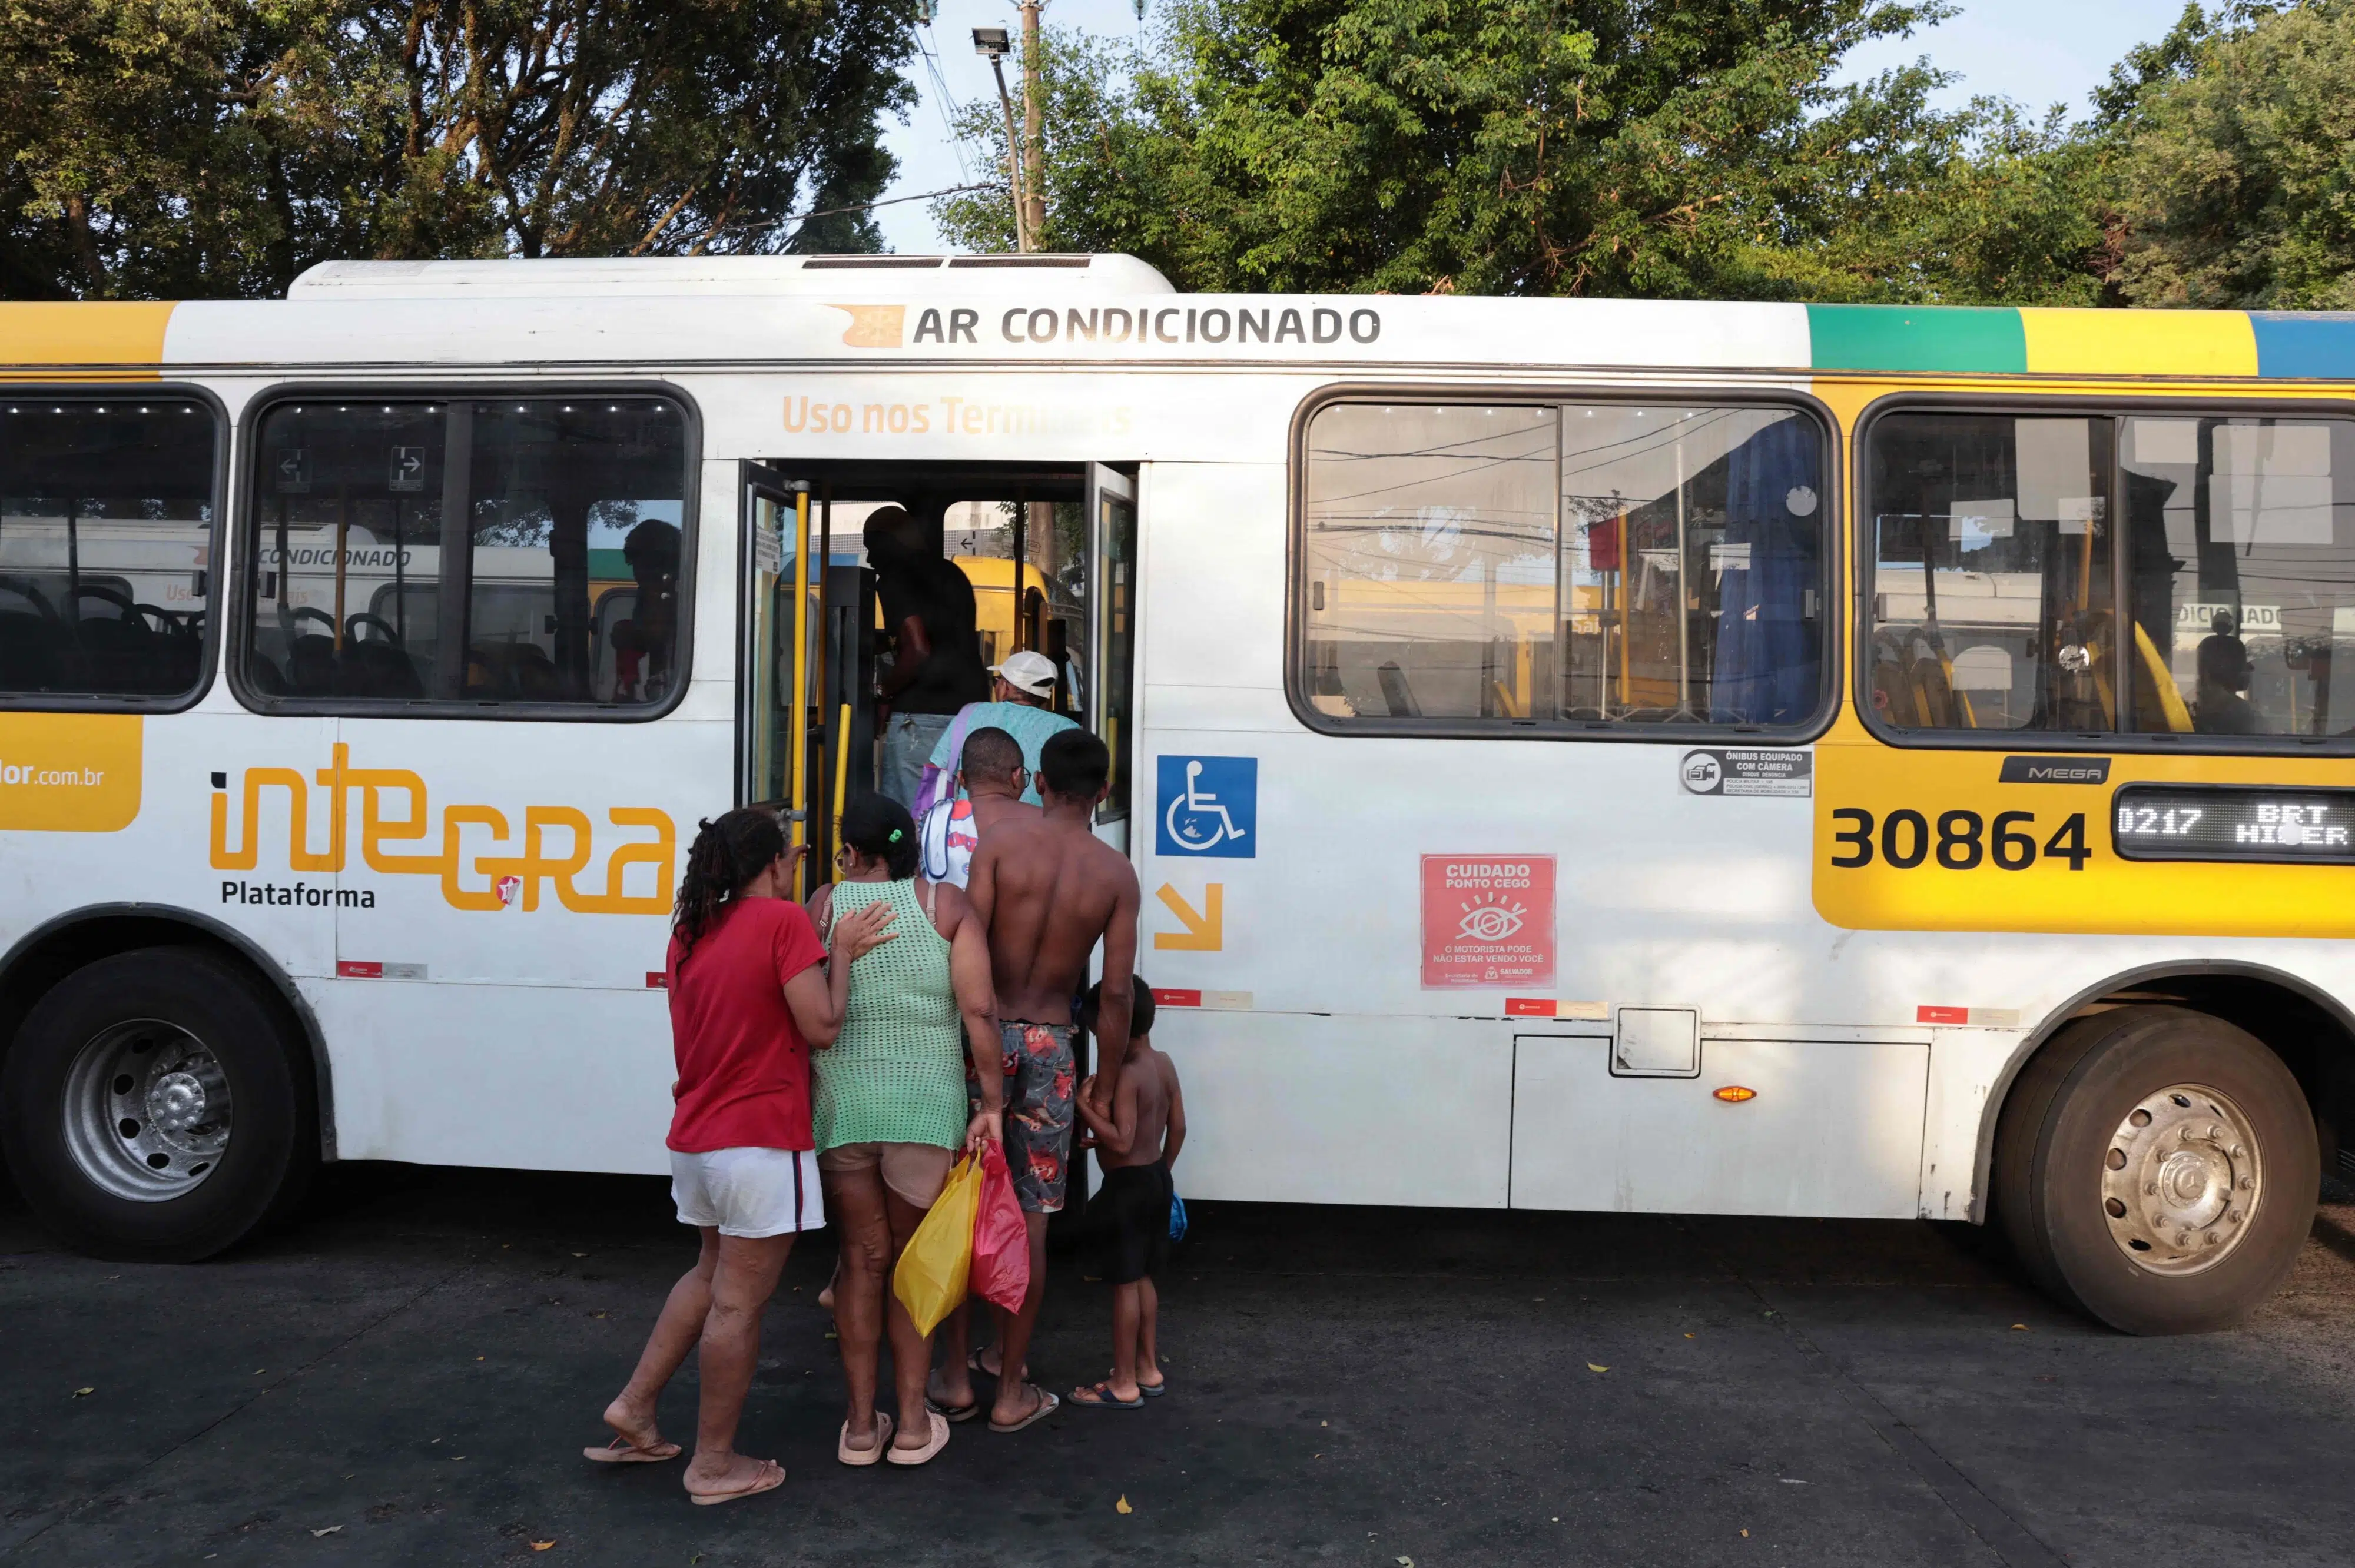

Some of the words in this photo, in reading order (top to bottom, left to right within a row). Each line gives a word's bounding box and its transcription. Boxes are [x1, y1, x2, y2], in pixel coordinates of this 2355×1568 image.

[913, 308, 979, 344] AR
[1001, 307, 1381, 344] CONDICIONADO
[784, 396, 853, 434] Uso
[863, 403, 930, 434] nos
[1726, 751, 1758, 761] ÔNIBUS
[1760, 753, 1803, 762] EQUIPADO
[1737, 762, 1756, 770] COM
[1757, 761, 1793, 772] CÂMERA
[2028, 767, 2102, 779] MEGA
[1831, 808, 2092, 871] 30864
[2236, 825, 2350, 845] HIER
[1445, 864, 1531, 878] CUIDADO
[1445, 879, 1490, 888] PONTO
[1494, 879, 1531, 888] CEGO
[222, 881, 375, 908] Plataforma
[1433, 954, 1453, 963] NÃO
[1455, 955, 1484, 963] ESTAR
[1485, 955, 1517, 963] VENDO
[1518, 954, 1544, 963] VOCÊ
